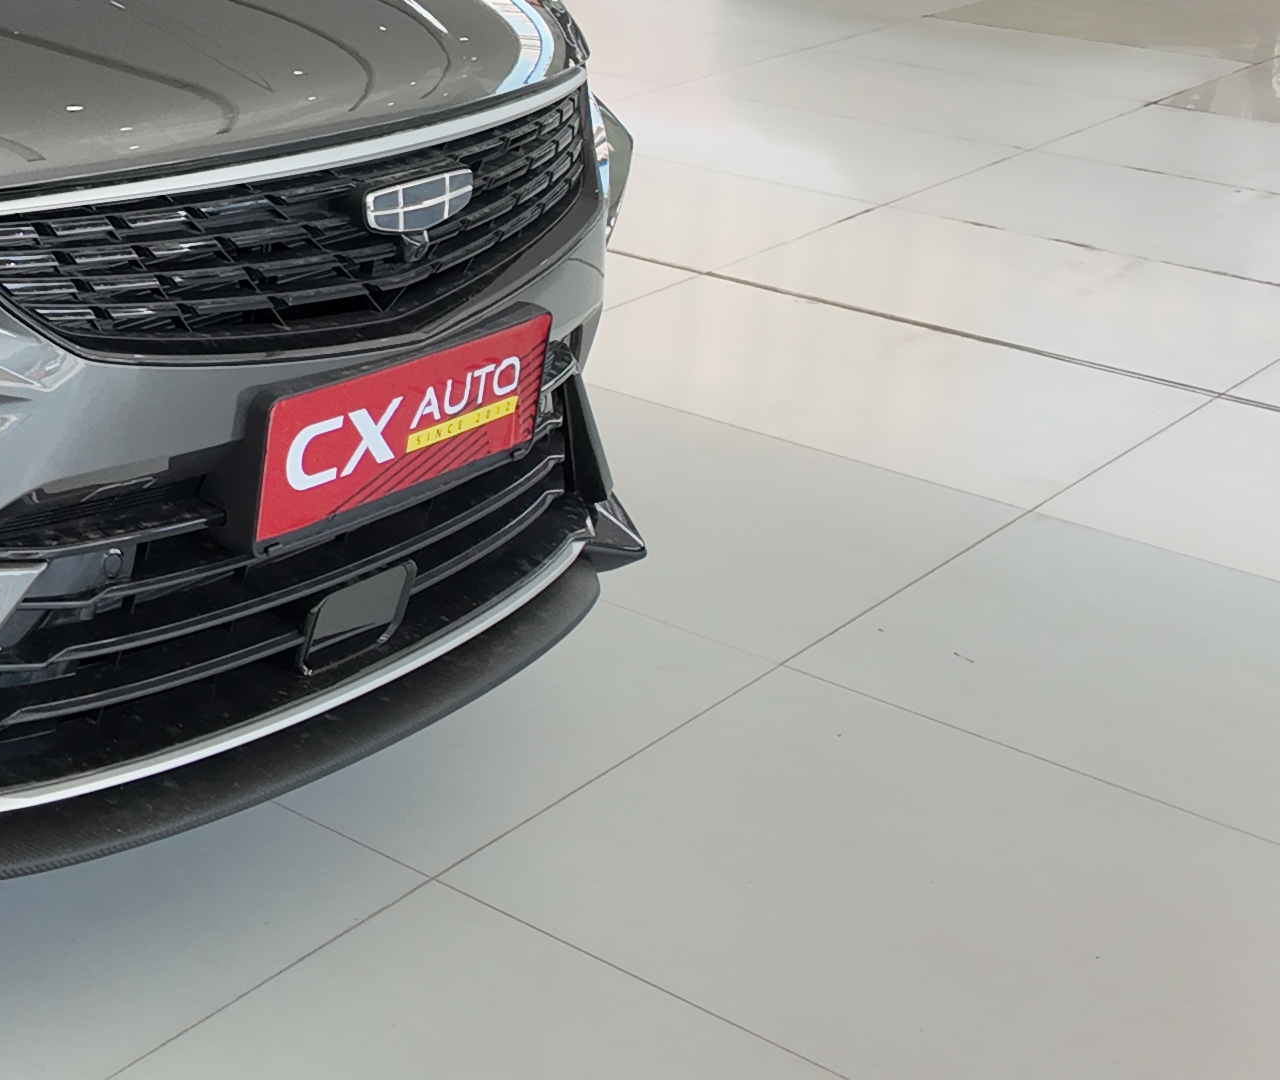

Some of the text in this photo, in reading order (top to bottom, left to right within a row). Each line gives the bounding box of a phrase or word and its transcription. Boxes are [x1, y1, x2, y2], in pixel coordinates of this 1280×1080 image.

[286, 356, 521, 491] CX AUTO
[416, 401, 511, 447] SINCE 2012
